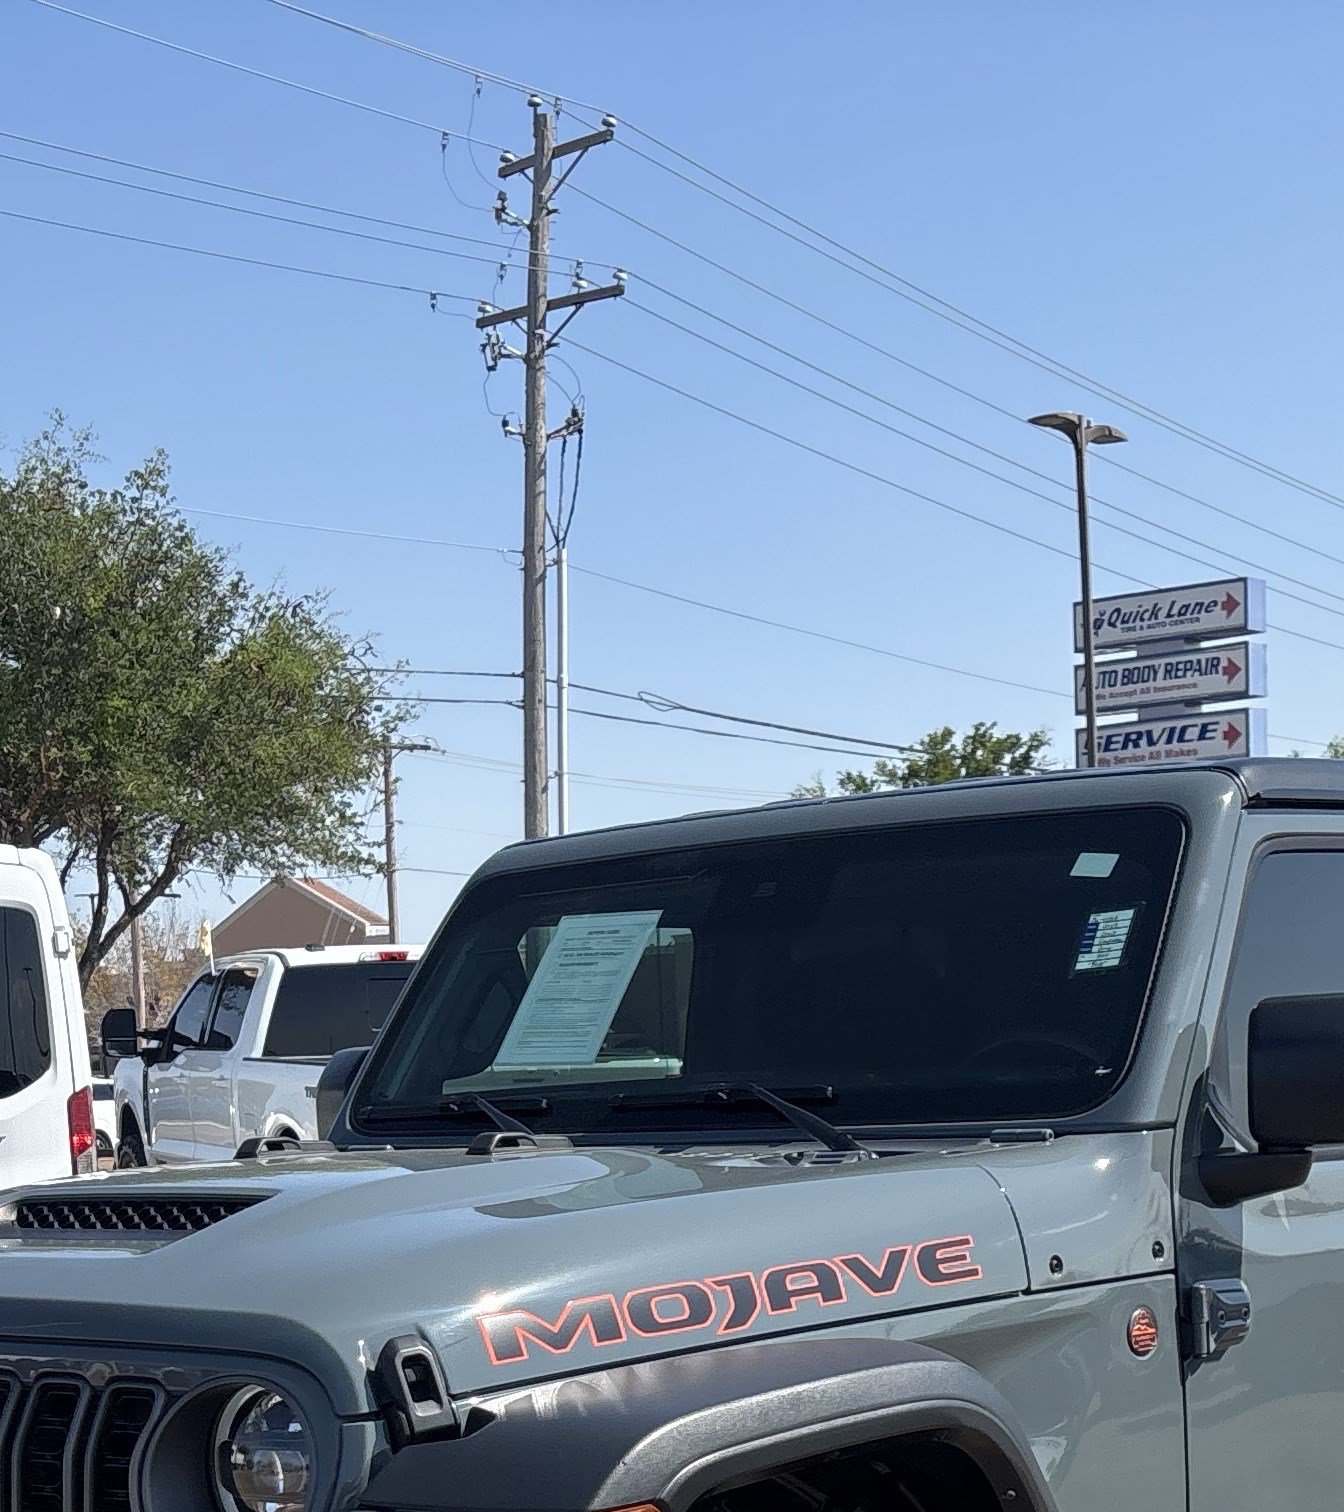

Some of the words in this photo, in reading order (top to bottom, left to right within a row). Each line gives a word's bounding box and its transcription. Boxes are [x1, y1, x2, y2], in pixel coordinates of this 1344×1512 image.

[1107, 602, 1163, 629] Quick
[1164, 599, 1219, 619] Lane
[1120, 663, 1162, 687] BODY
[1162, 656, 1221, 681] REPAIR
[476, 1235, 984, 1366] MOJAVE
